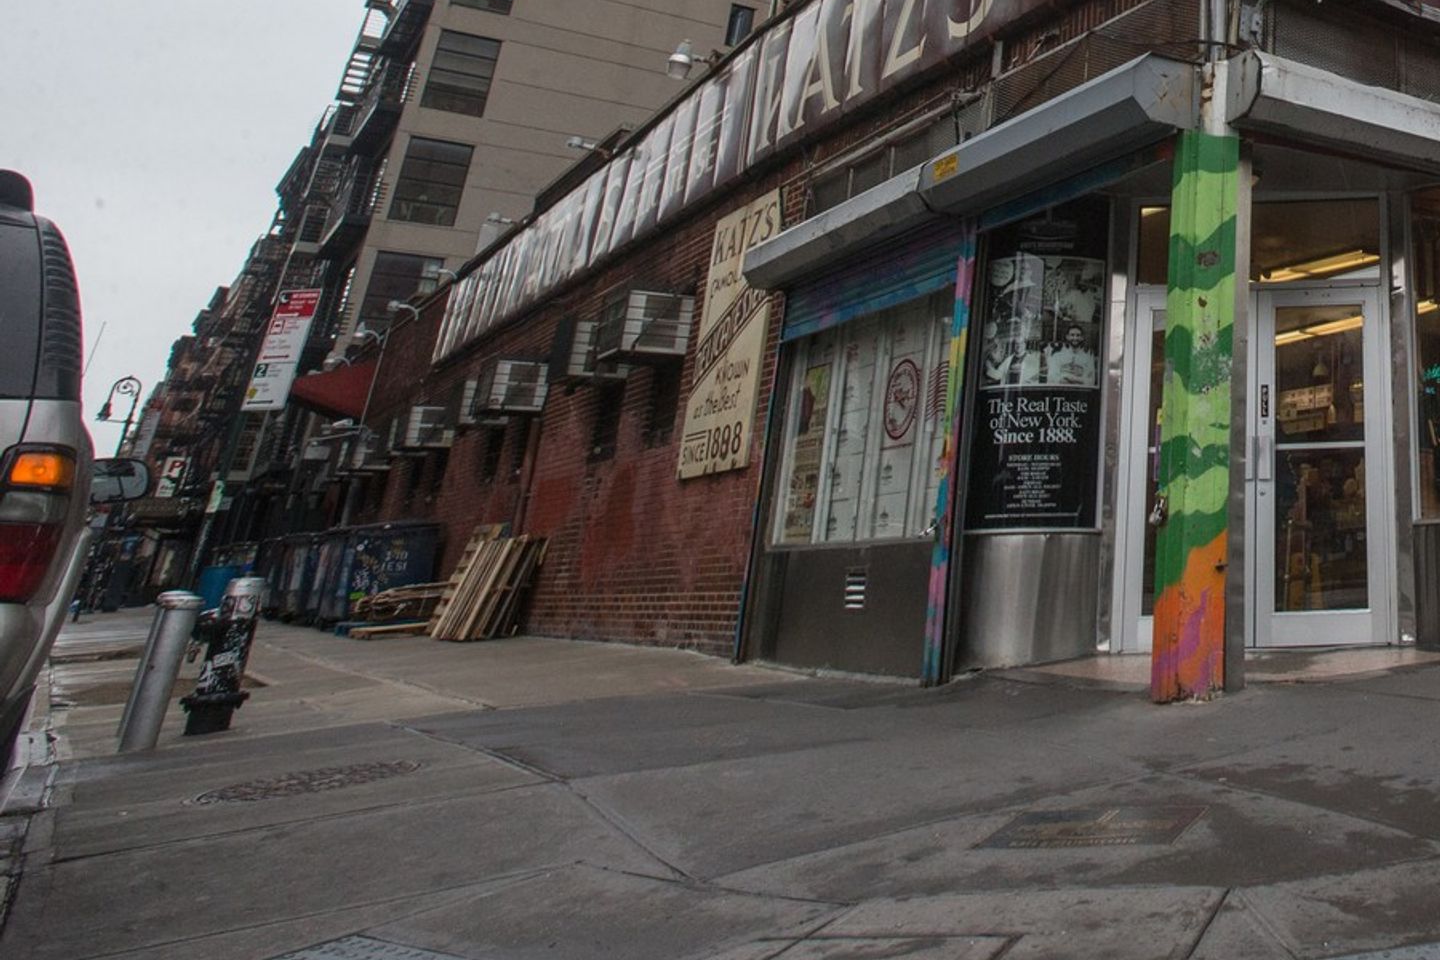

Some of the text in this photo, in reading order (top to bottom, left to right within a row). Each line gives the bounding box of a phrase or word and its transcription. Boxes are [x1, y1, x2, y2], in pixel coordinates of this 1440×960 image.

[988, 396, 1088, 414] The Real Taste
[990, 412, 1082, 429] of New York.
[682, 421, 743, 466] SINCE 1888
[993, 427, 1077, 445] Since 1888.
